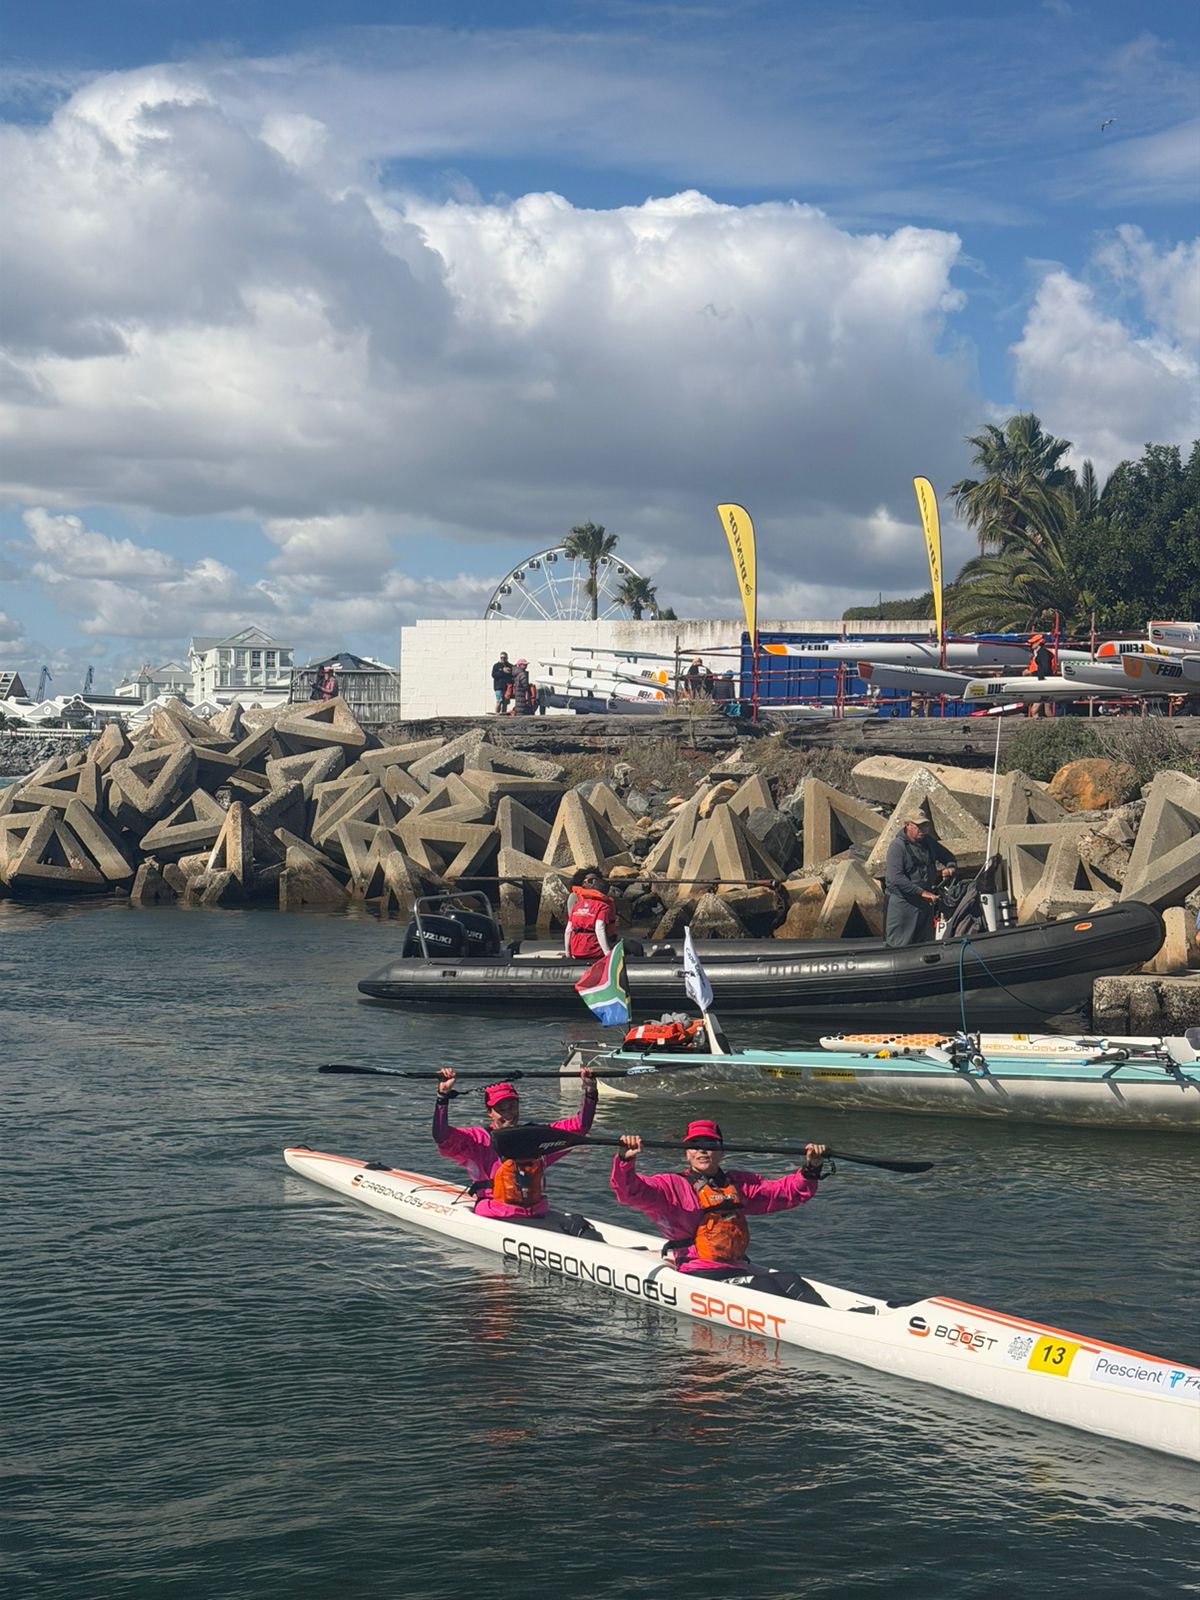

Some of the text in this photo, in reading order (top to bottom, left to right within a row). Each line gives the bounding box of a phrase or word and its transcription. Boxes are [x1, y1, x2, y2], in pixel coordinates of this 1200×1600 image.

[361, 1180, 458, 1216] CARBONOLOGY SPORT
[503, 1237, 786, 1338] CARBONOLOGY SPORT
[934, 1325, 998, 1350] BOOST
[1043, 1344, 1067, 1365] 13
[1096, 1358, 1163, 1384] Prescient
